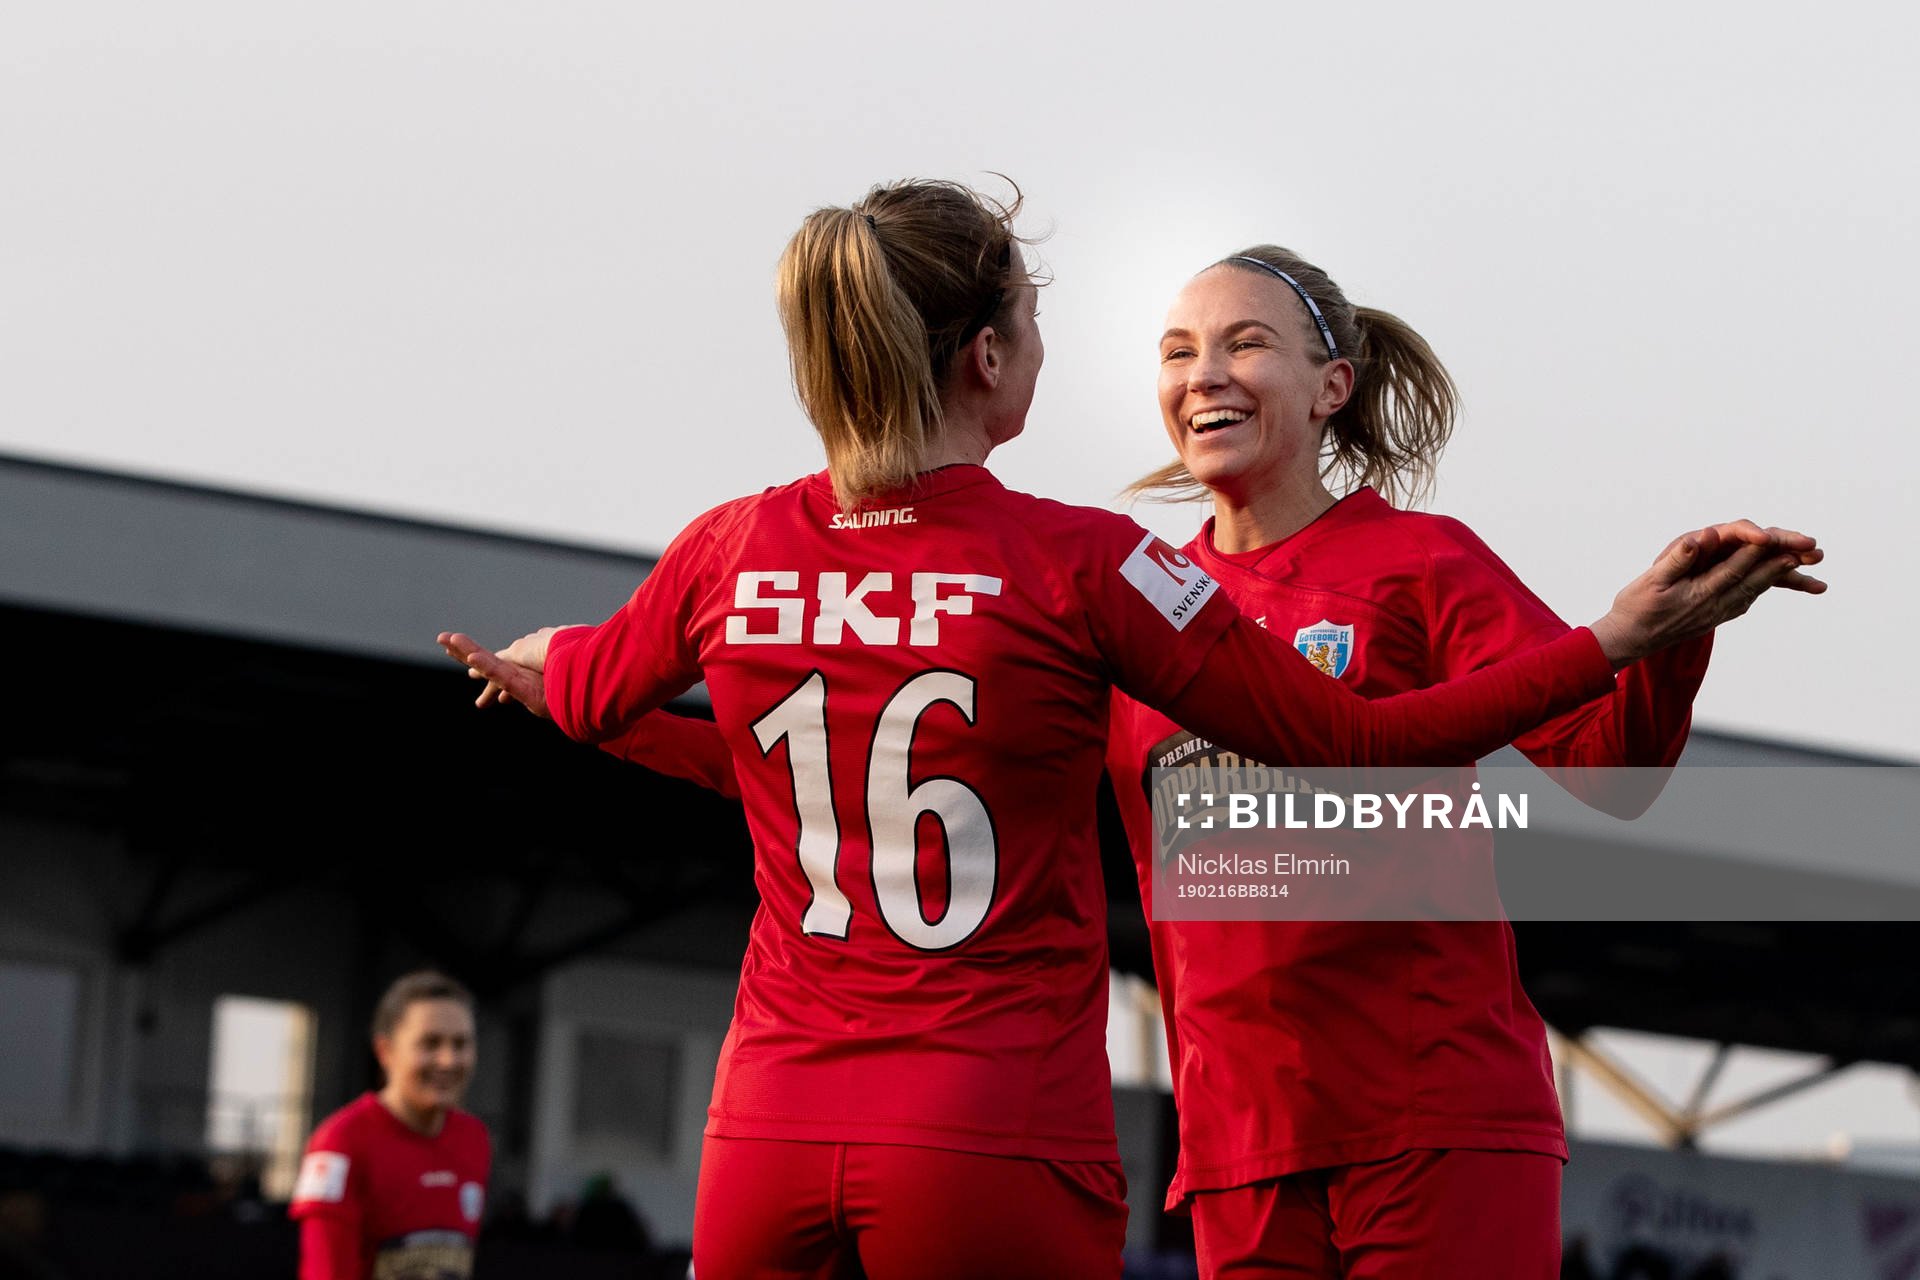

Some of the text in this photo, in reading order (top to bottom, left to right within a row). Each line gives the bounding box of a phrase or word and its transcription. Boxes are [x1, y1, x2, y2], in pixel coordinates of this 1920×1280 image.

[725, 570, 1003, 647] SKF
[1172, 574, 1211, 620] SVENSK
[749, 667, 998, 953] 16
